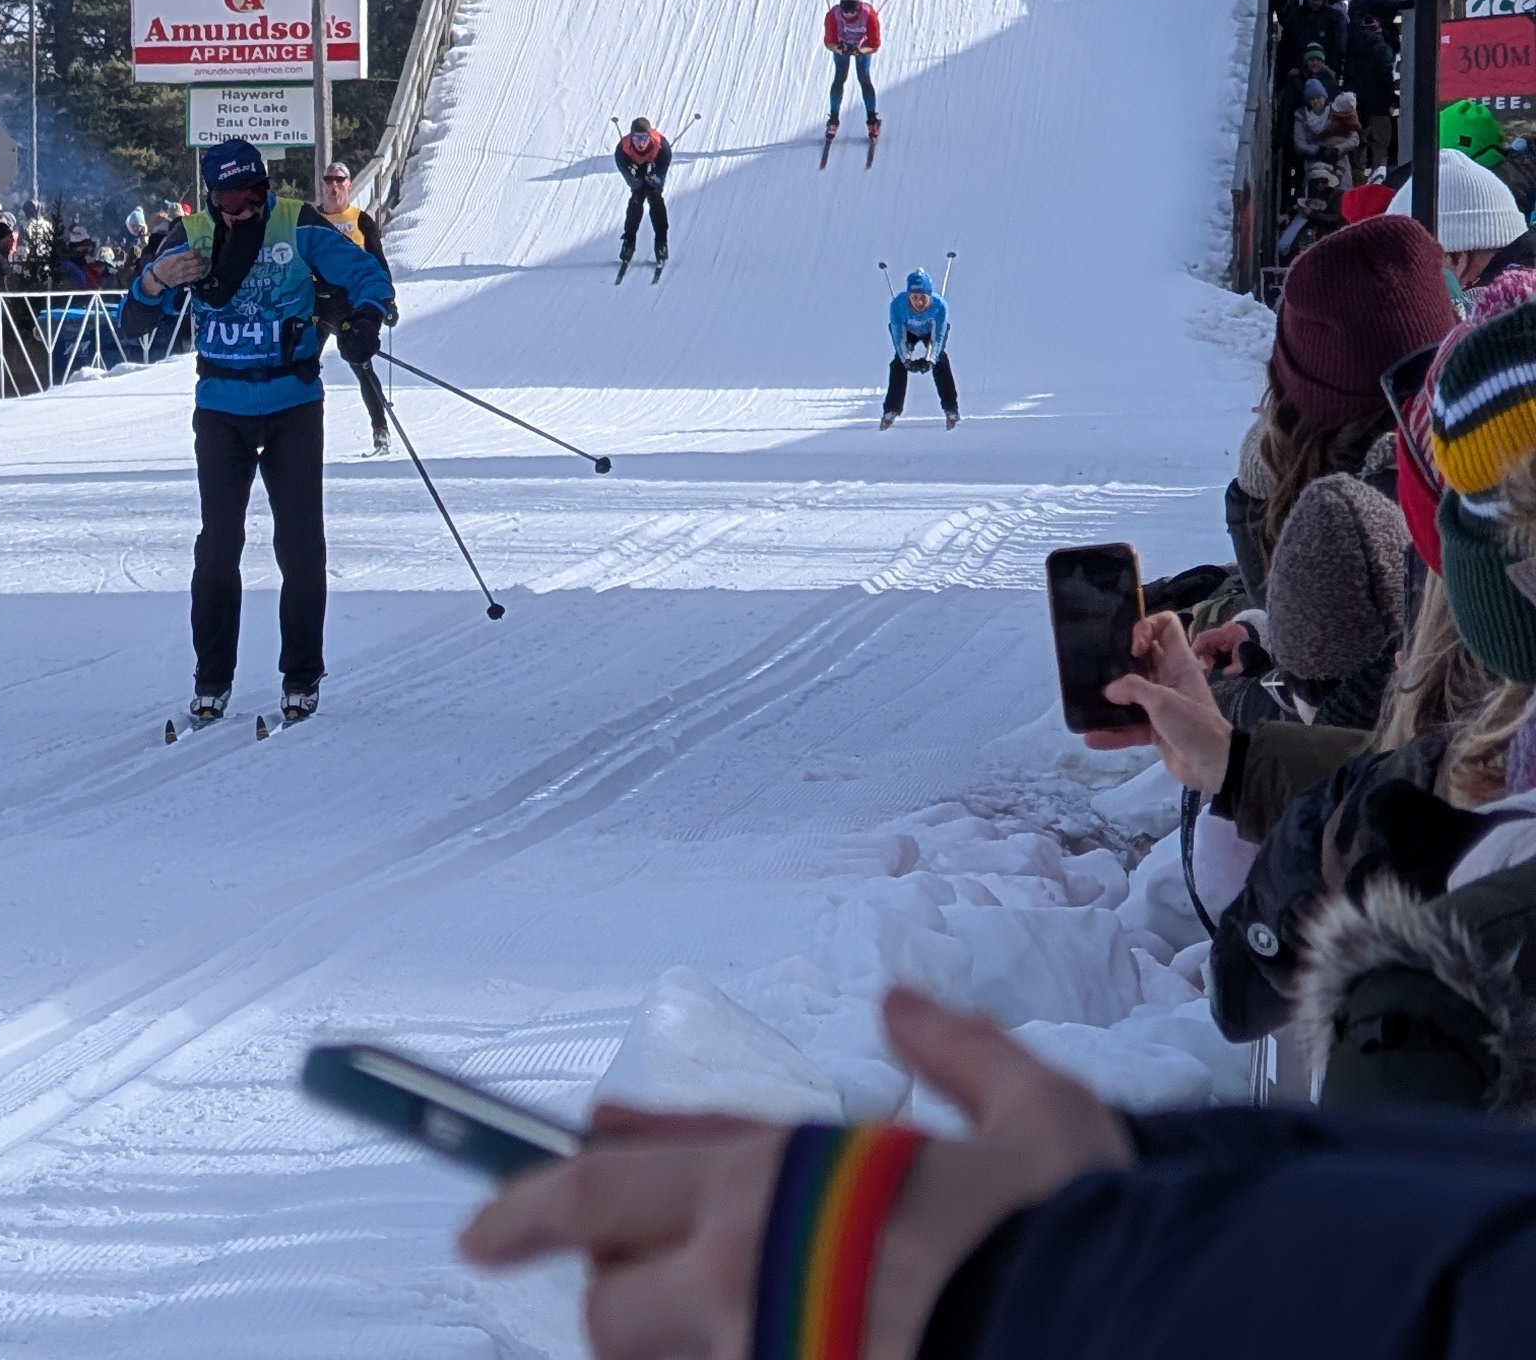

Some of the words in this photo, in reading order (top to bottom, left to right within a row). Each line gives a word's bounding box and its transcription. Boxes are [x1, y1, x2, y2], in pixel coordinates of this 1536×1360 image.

[190, 45, 308, 62] APPLIANCE
[1458, 42, 1532, 74] 300M
[194, 66, 304, 77] amundsonsappliance.com
[221, 89, 285, 102] Hayward
[217, 103, 249, 114] Rice
[254, 103, 288, 114] Lake
[216, 118, 244, 128] Eau
[248, 116, 290, 128] Claire
[274, 130, 309, 141] Falls
